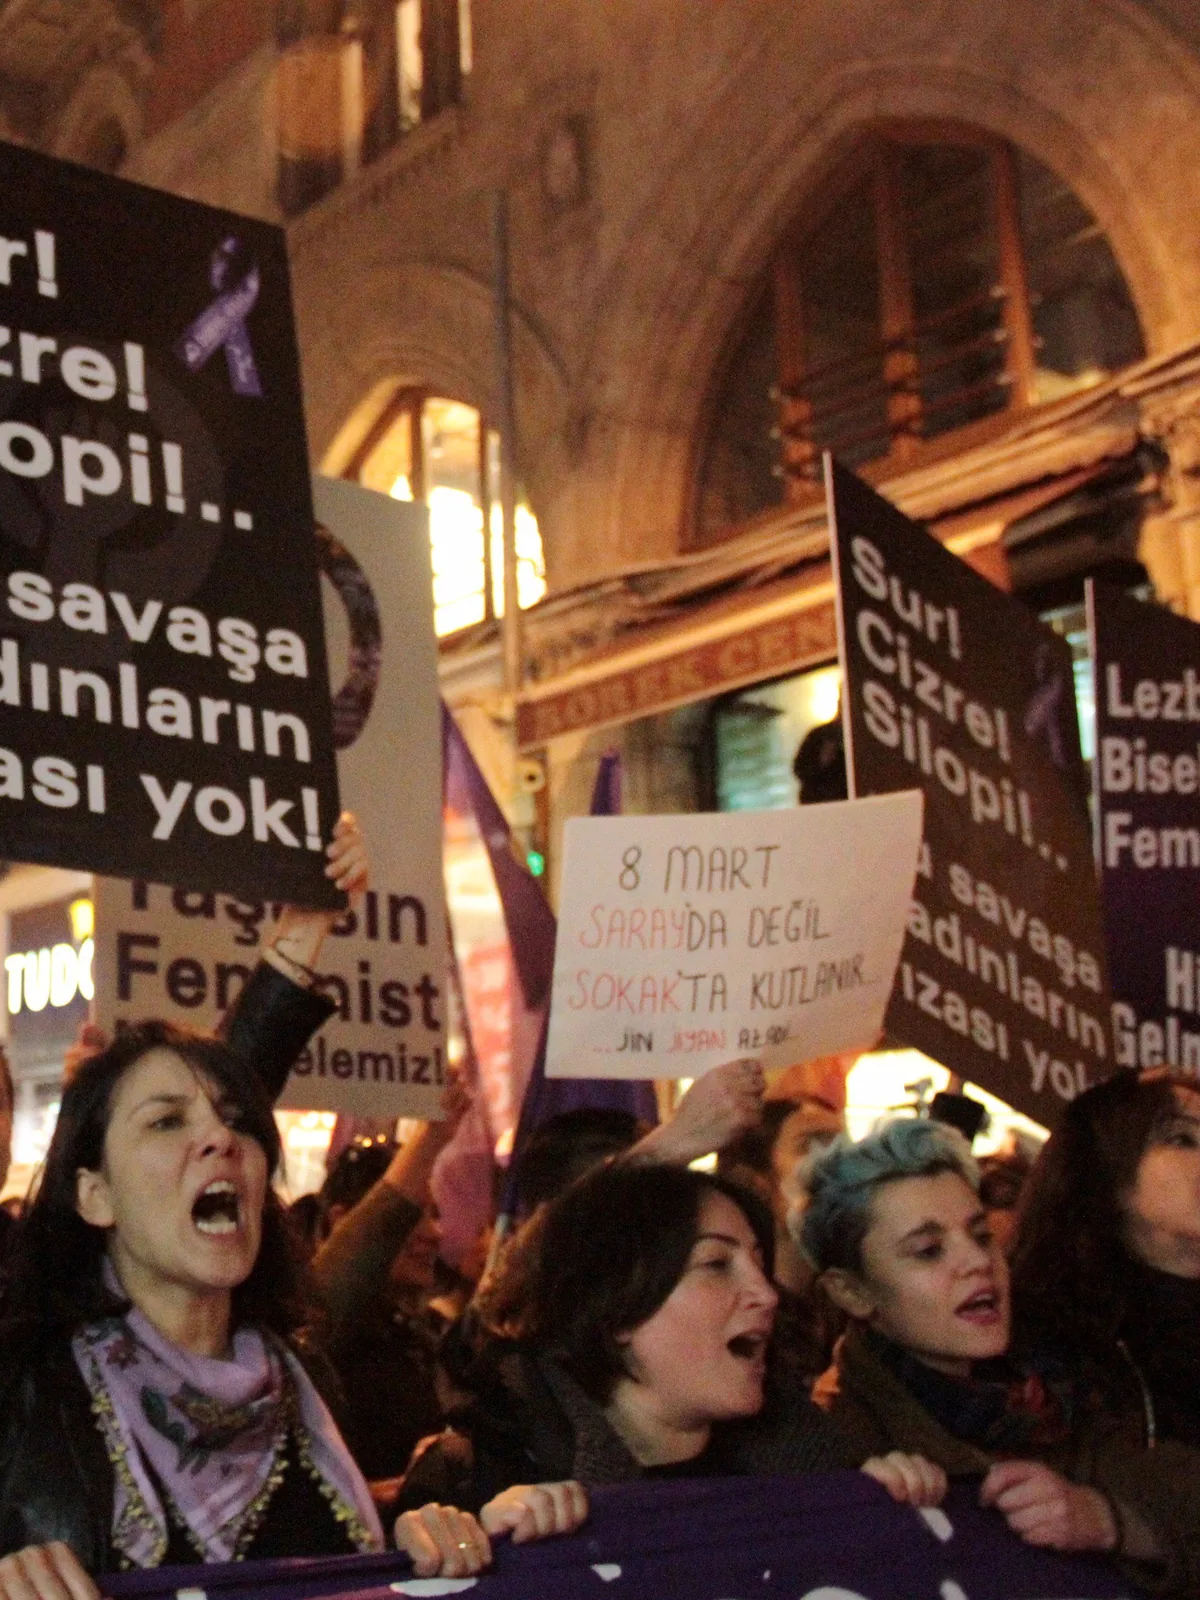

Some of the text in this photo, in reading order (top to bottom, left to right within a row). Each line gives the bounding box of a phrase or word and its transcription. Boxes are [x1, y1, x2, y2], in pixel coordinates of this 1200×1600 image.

[7, 569, 309, 682] savaşa
[851, 536, 961, 661] Sur!
[857, 610, 1011, 761] Cizre!
[141, 773, 324, 852] yok!
[1102, 737, 1200, 794] Bise
[618, 845, 781, 893] 8 MART
[906, 900, 1106, 1059] adınların
[950, 863, 1100, 991] savaşa
[292, 1036, 445, 1085] elemiz!
[902, 962, 1009, 1060] ızası
